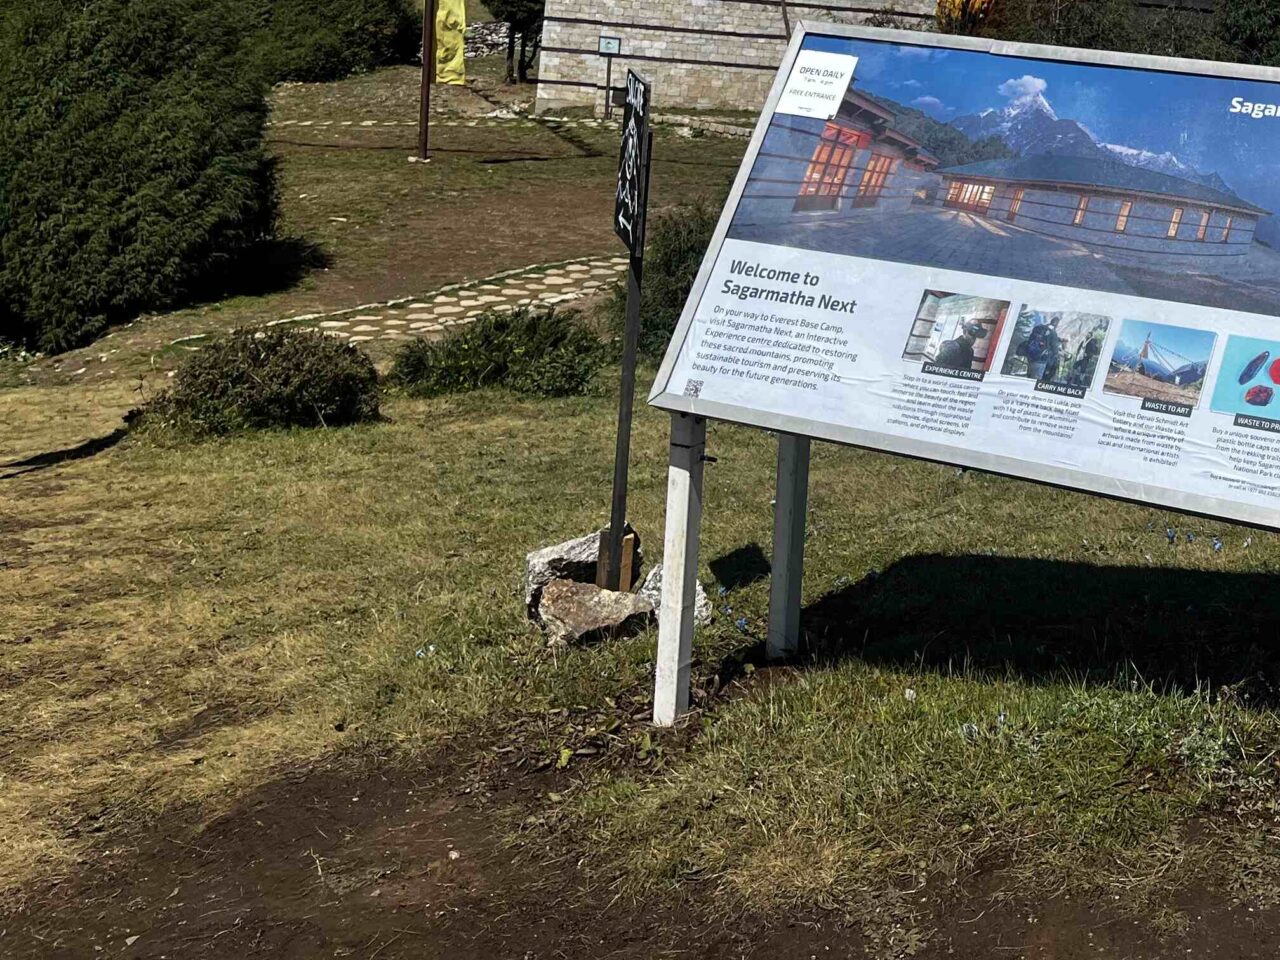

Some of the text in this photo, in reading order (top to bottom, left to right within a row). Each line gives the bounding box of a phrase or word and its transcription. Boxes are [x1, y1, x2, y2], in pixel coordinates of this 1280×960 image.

[799, 67, 844, 79] OPEN DAILY
[804, 91, 836, 101] ENTRANCE
[730, 260, 819, 286] Welcome to
[722, 280, 857, 313] Sagarmatha Next
[709, 318, 726, 326] visit
[727, 319, 772, 334] Sagarmatha
[773, 327, 792, 337] Next,
[806, 333, 848, 347] Interactive
[713, 305, 843, 334] On your way to Everest Base Camp,
[701, 340, 834, 370] these sacred mountains, promoting
[705, 328, 858, 362] Experience centre dedicated to restoring
[692, 362, 817, 390] beauty for the future generations.
[697, 352, 842, 383] sustainable tourism and preserving its
[925, 365, 981, 379] EXPERIENCE CENTRE
[1037, 383, 1056, 391] CARRY
[1145, 402, 1166, 411] WASTE
[1238, 418, 1260, 427] WASTE
